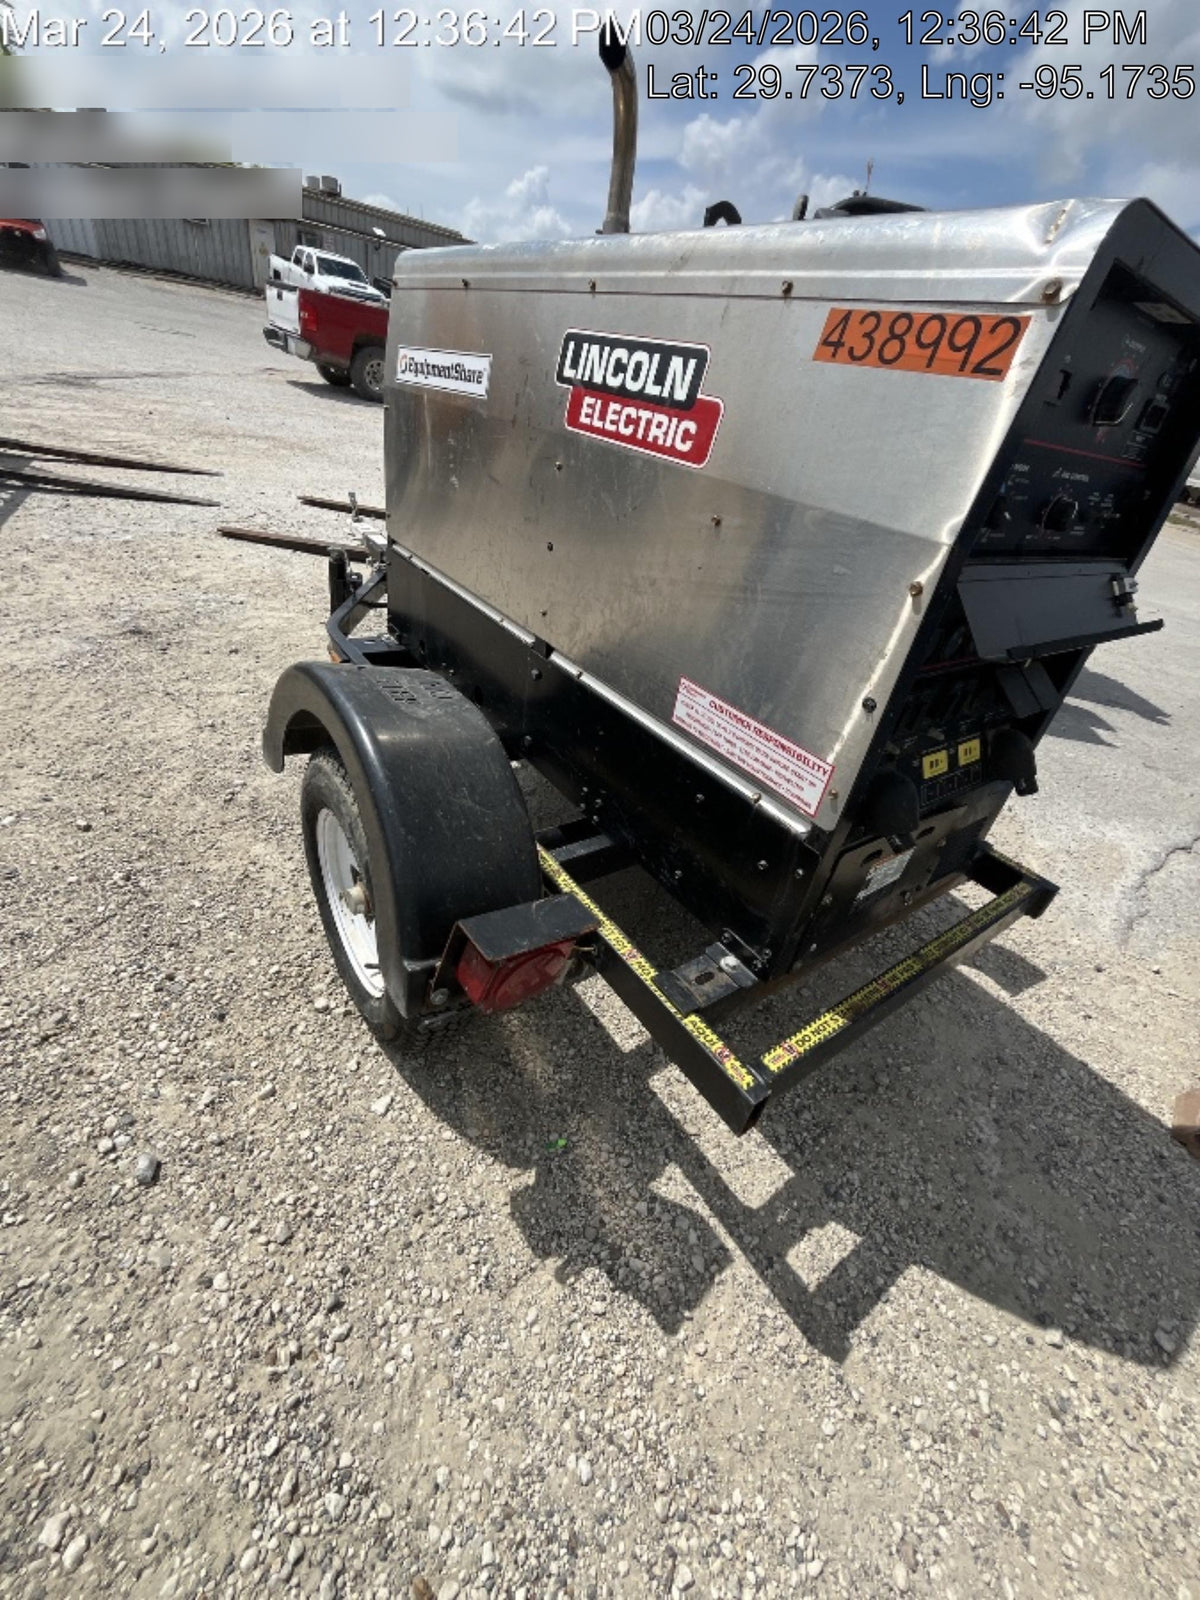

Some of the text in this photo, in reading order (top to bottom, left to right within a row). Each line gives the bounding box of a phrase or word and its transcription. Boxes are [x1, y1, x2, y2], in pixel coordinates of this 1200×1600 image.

[562, 340, 698, 402] LINCOLN
[821, 310, 1022, 376] 438992
[579, 396, 698, 452] ELECTRIC
